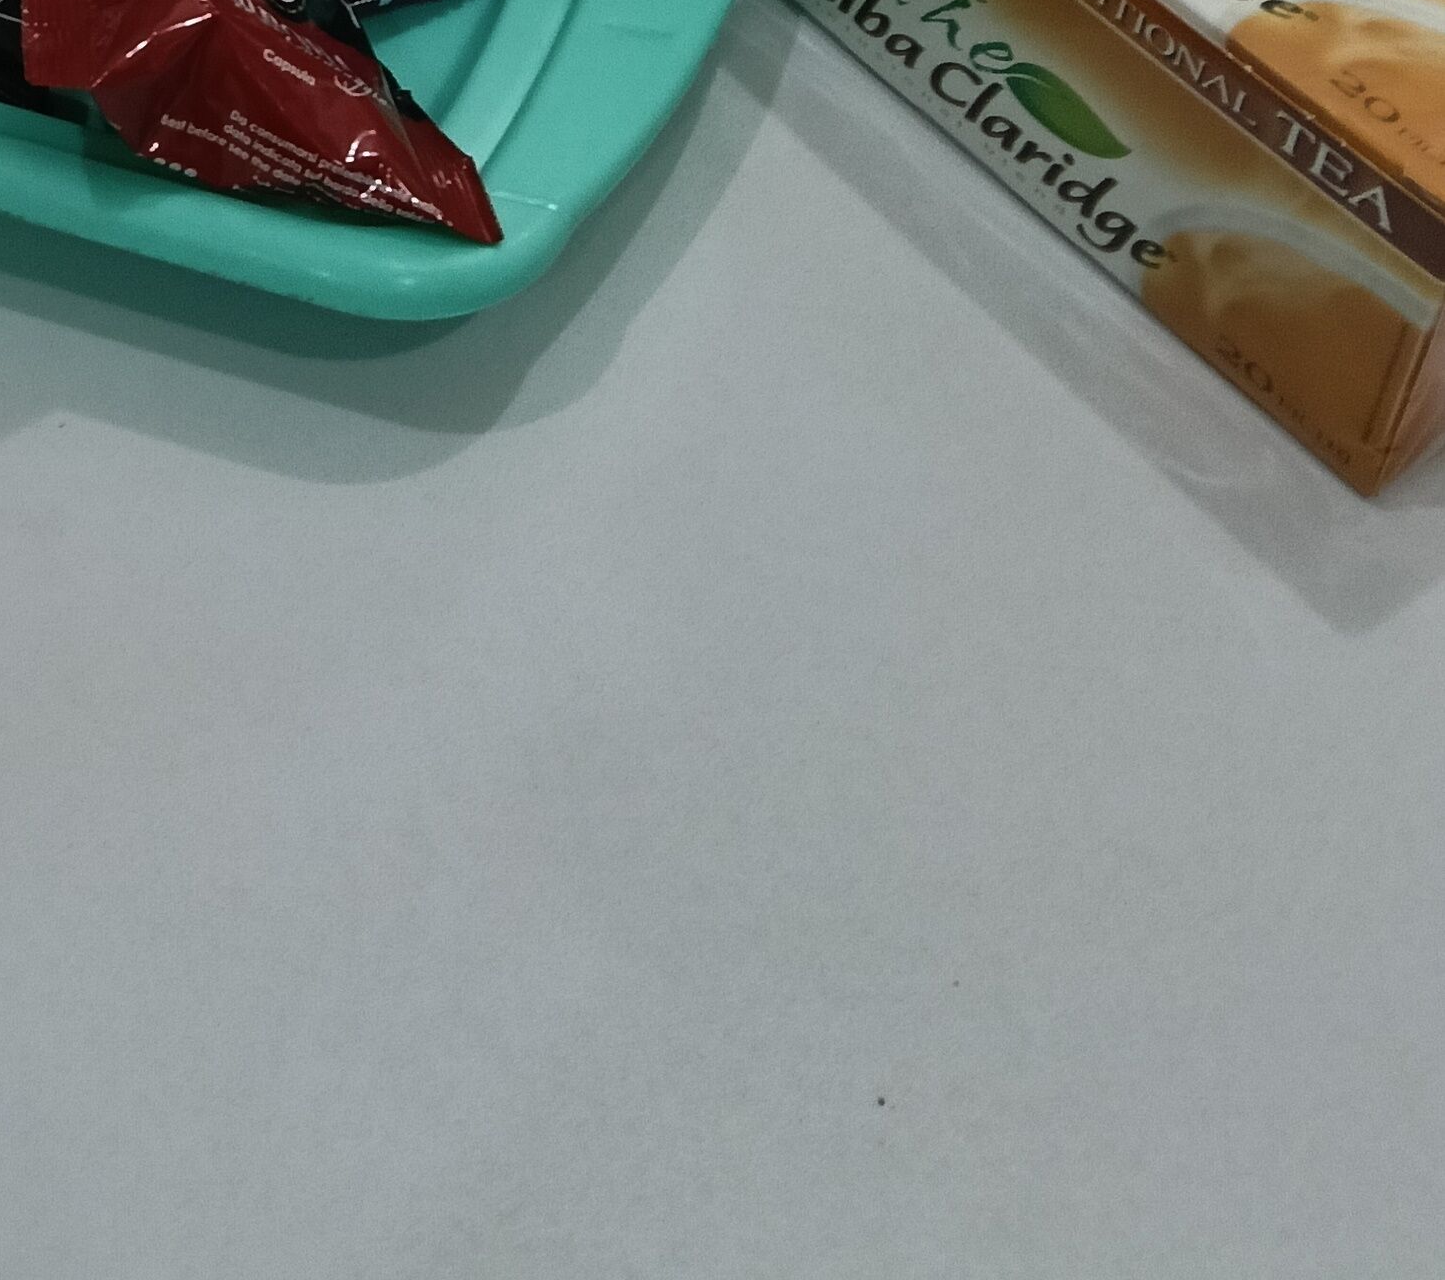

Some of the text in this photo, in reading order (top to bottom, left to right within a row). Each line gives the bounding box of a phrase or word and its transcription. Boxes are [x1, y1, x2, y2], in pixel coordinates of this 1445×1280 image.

[262, 47, 317, 87] Capsula
[186, 122, 228, 147] before
[929, 61, 1166, 271] Claridge
[1275, 109, 1392, 234] TEA
